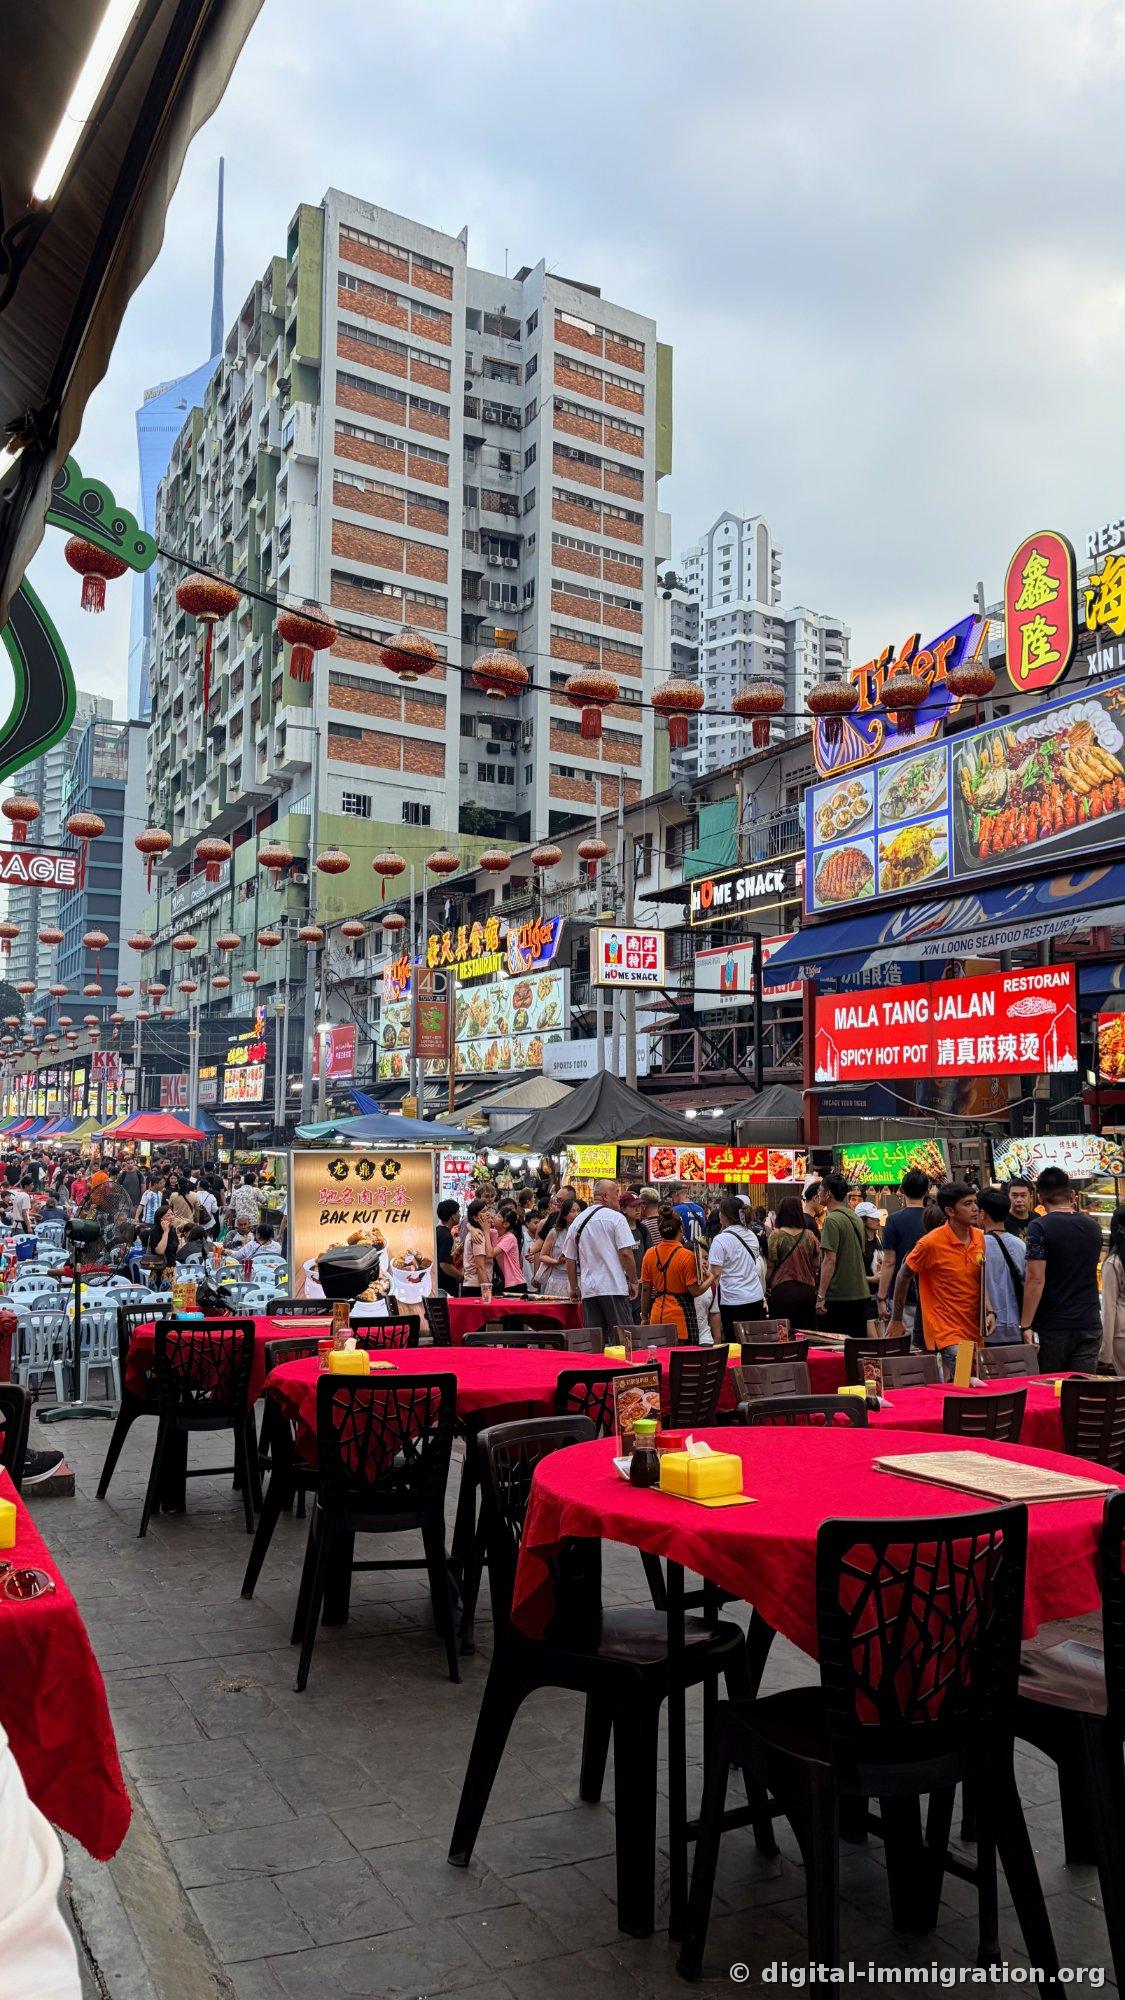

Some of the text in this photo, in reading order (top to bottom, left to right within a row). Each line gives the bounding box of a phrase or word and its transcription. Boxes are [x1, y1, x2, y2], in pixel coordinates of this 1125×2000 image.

[1014, 548, 1061, 679] 鑫隆
[1087, 647, 1114, 676] XIN
[0, 854, 75, 885] AGE
[693, 880, 732, 911] HOME
[736, 869, 785, 900] SNACK
[520, 917, 553, 957] Tiger
[628, 937, 655, 951] 南洋
[922, 943, 939, 956] XIN
[941, 939, 974, 953] LOONG
[976, 930, 1020, 948] SEAFOOD
[460, 953, 503, 980] RESTAURANT
[629, 954, 655, 968] 特产
[419, 971, 447, 993] 4D
[605, 969, 658, 981] HOME SNACK
[1003, 972, 1070, 993] RESTORAN
[834, 1005, 879, 1030] MALA
[882, 998, 928, 1025] TANG
[933, 991, 995, 1021] JALAN
[94, 1051, 116, 1066] KK
[840, 1033, 1040, 1066] SPICY HOT POT 清真麻辣烫
[553, 1060, 588, 1070] SPORTS TOTO
[859, 1171, 894, 1181] shashlik
[320, 1208, 410, 1225] BAK KUT TEH
